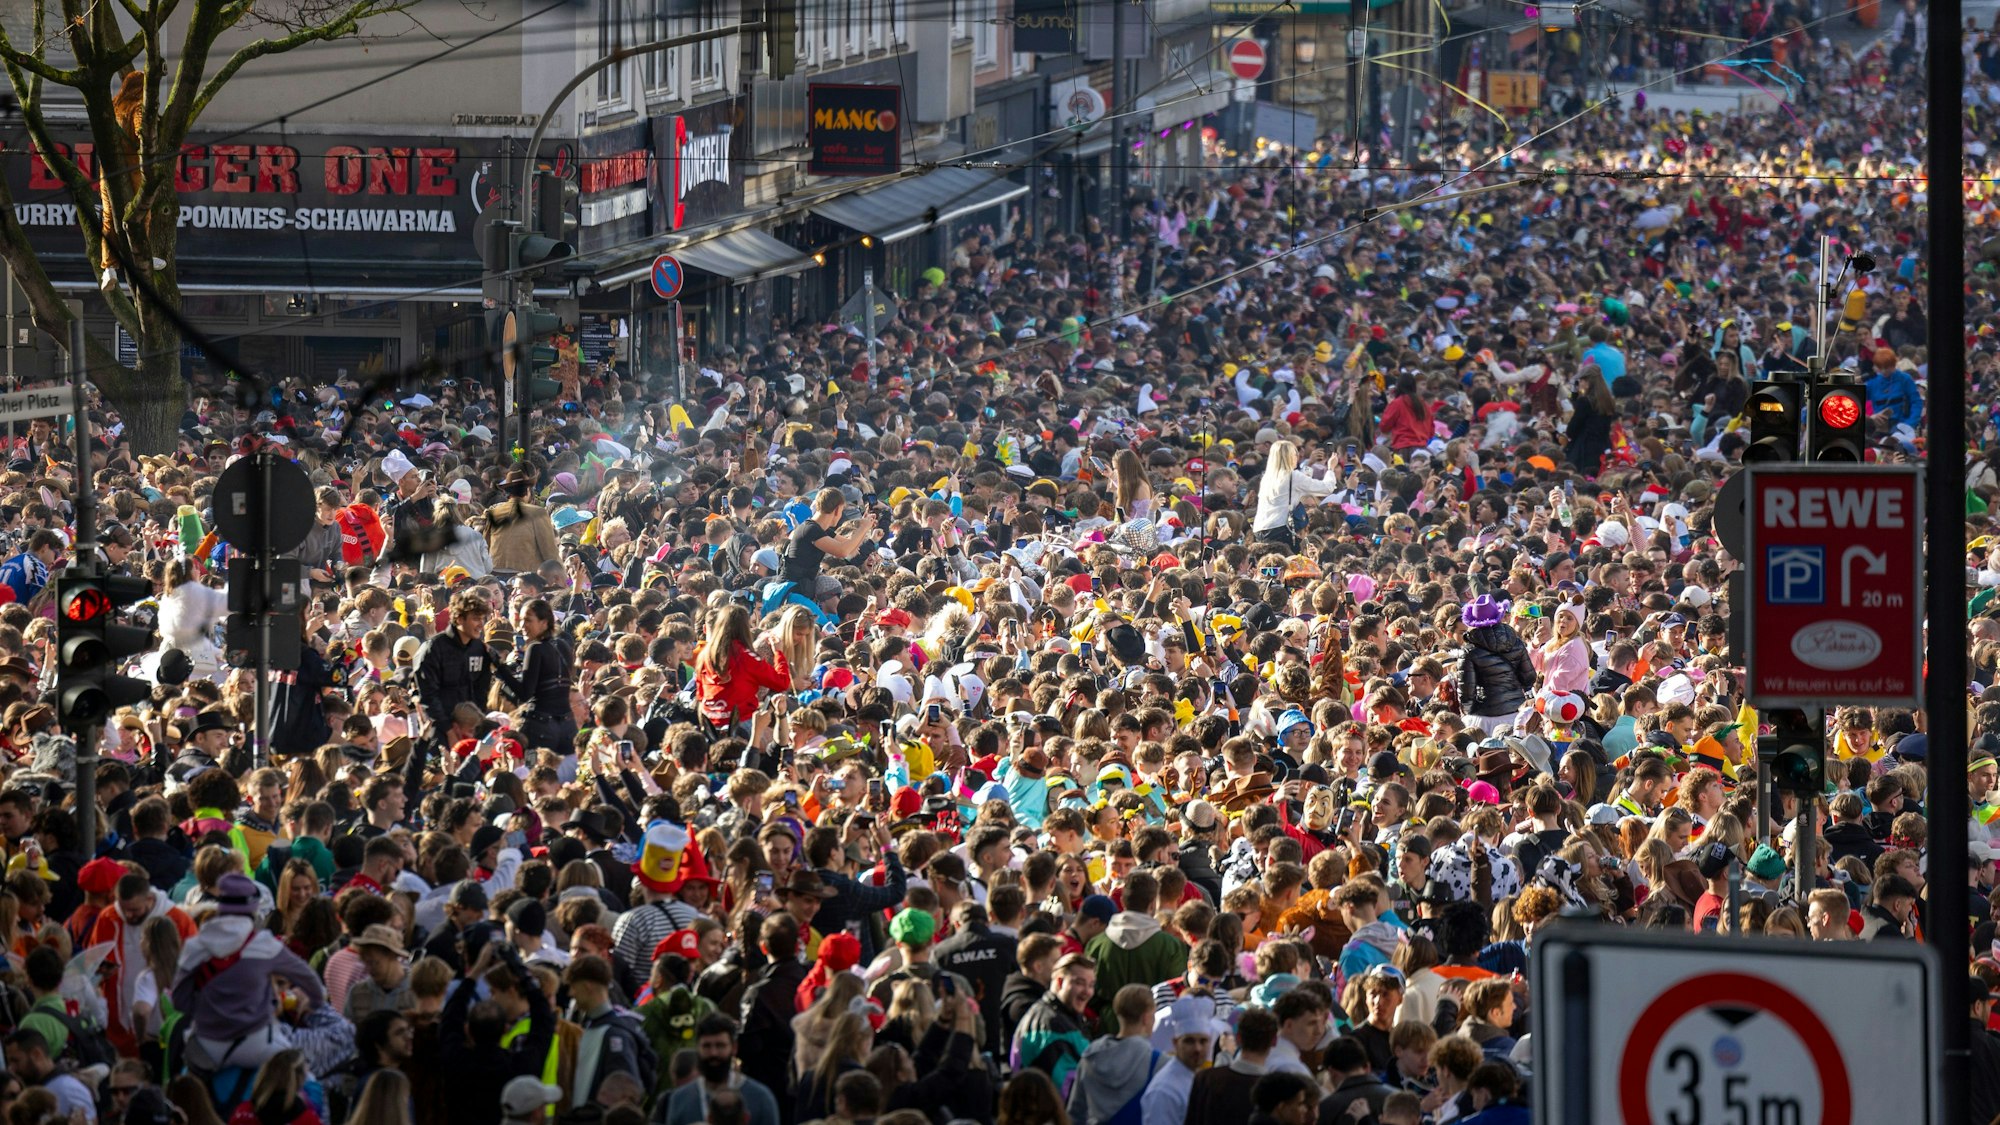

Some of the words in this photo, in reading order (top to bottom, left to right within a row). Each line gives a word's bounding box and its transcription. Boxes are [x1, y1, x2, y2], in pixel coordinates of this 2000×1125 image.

[814, 107, 896, 132] MANGO
[864, 144, 884, 155] bar
[324, 146, 457, 196] ONE
[681, 129, 731, 199] DÖNERFLIX
[27, 394, 60, 411] Platz
[1764, 487, 1905, 528] REWE
[1862, 592, 1883, 607] 20
[1887, 595, 1903, 607] m
[469, 656, 484, 672] FBI
[1763, 677, 1784, 690] Wir
[1788, 677, 1831, 691] freuen
[1834, 679, 1856, 691] uns
[1860, 677, 1883, 691] auf
[1885, 677, 1904, 691] Sie
